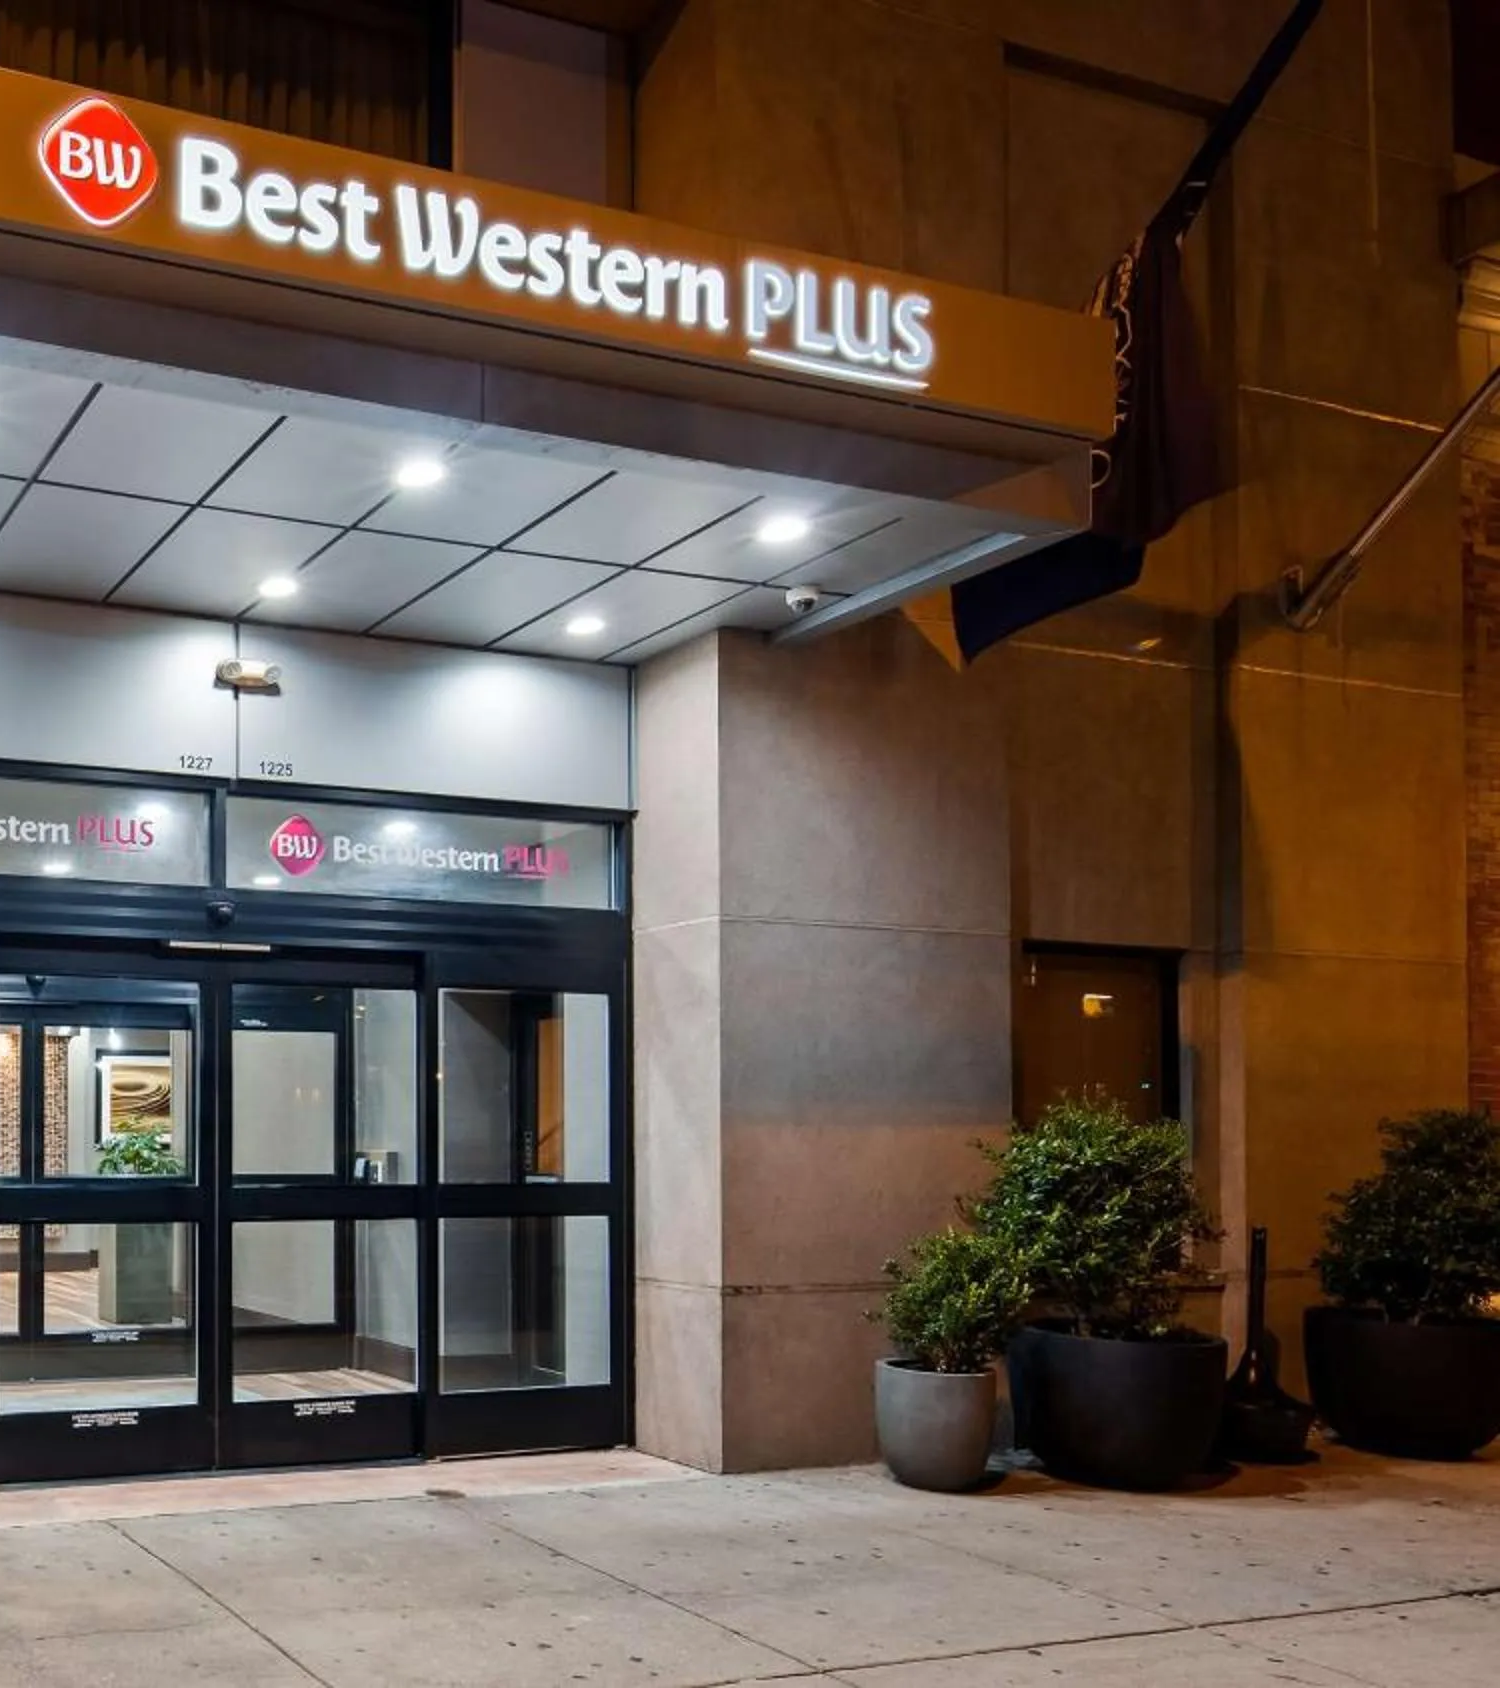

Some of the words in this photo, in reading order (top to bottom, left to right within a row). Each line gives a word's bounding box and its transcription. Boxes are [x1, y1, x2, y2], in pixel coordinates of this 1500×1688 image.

[59, 131, 142, 190] BW
[178, 136, 382, 262] Best
[395, 184, 731, 331] Western
[745, 259, 935, 373] PLUS
[179, 754, 213, 771] 1227
[259, 760, 293, 777] 1225
[75, 814, 155, 847] PLUS
[276, 833, 318, 859] BW
[332, 835, 391, 865] Best
